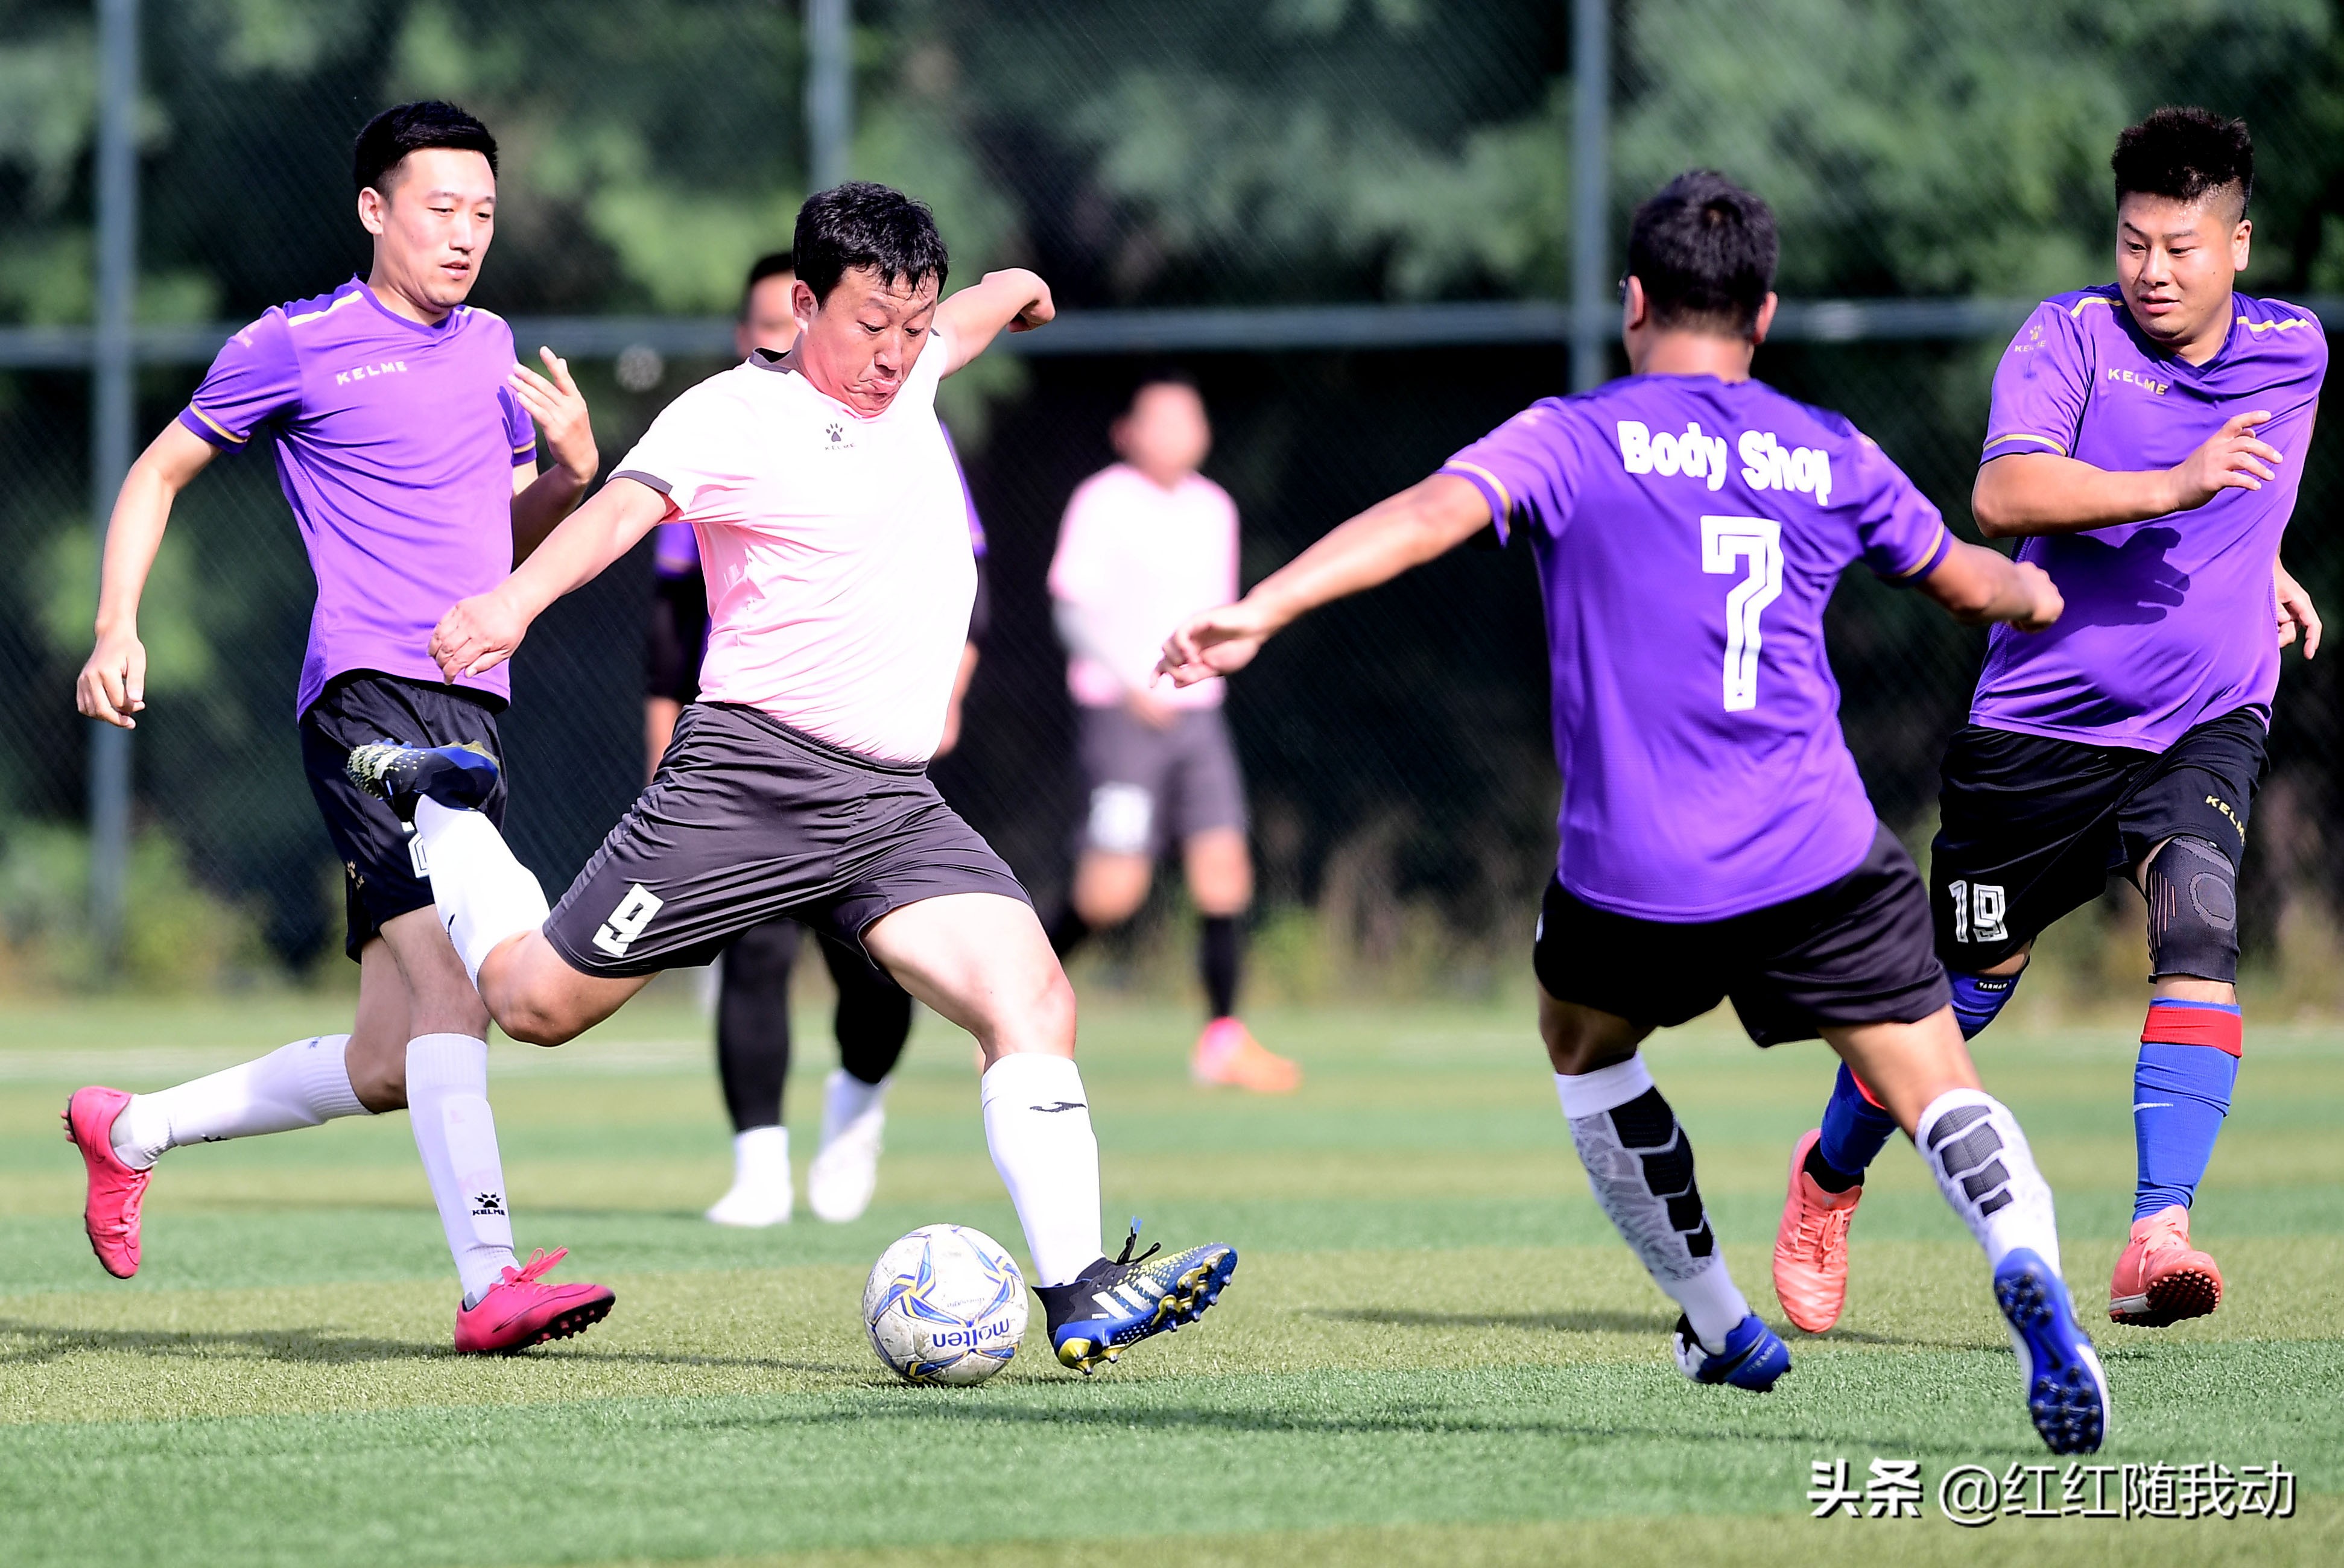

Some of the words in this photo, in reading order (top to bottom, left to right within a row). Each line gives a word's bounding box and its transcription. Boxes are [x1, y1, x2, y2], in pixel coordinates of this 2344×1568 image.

[336, 361, 407, 385] KELME
[2108, 368, 2168, 396] KELME
[1617, 420, 1728, 492] Body
[1700, 515, 1785, 712] 7
[592, 883, 664, 958] 9
[1948, 880, 2009, 944] 19
[933, 1318, 1010, 1347] molten
